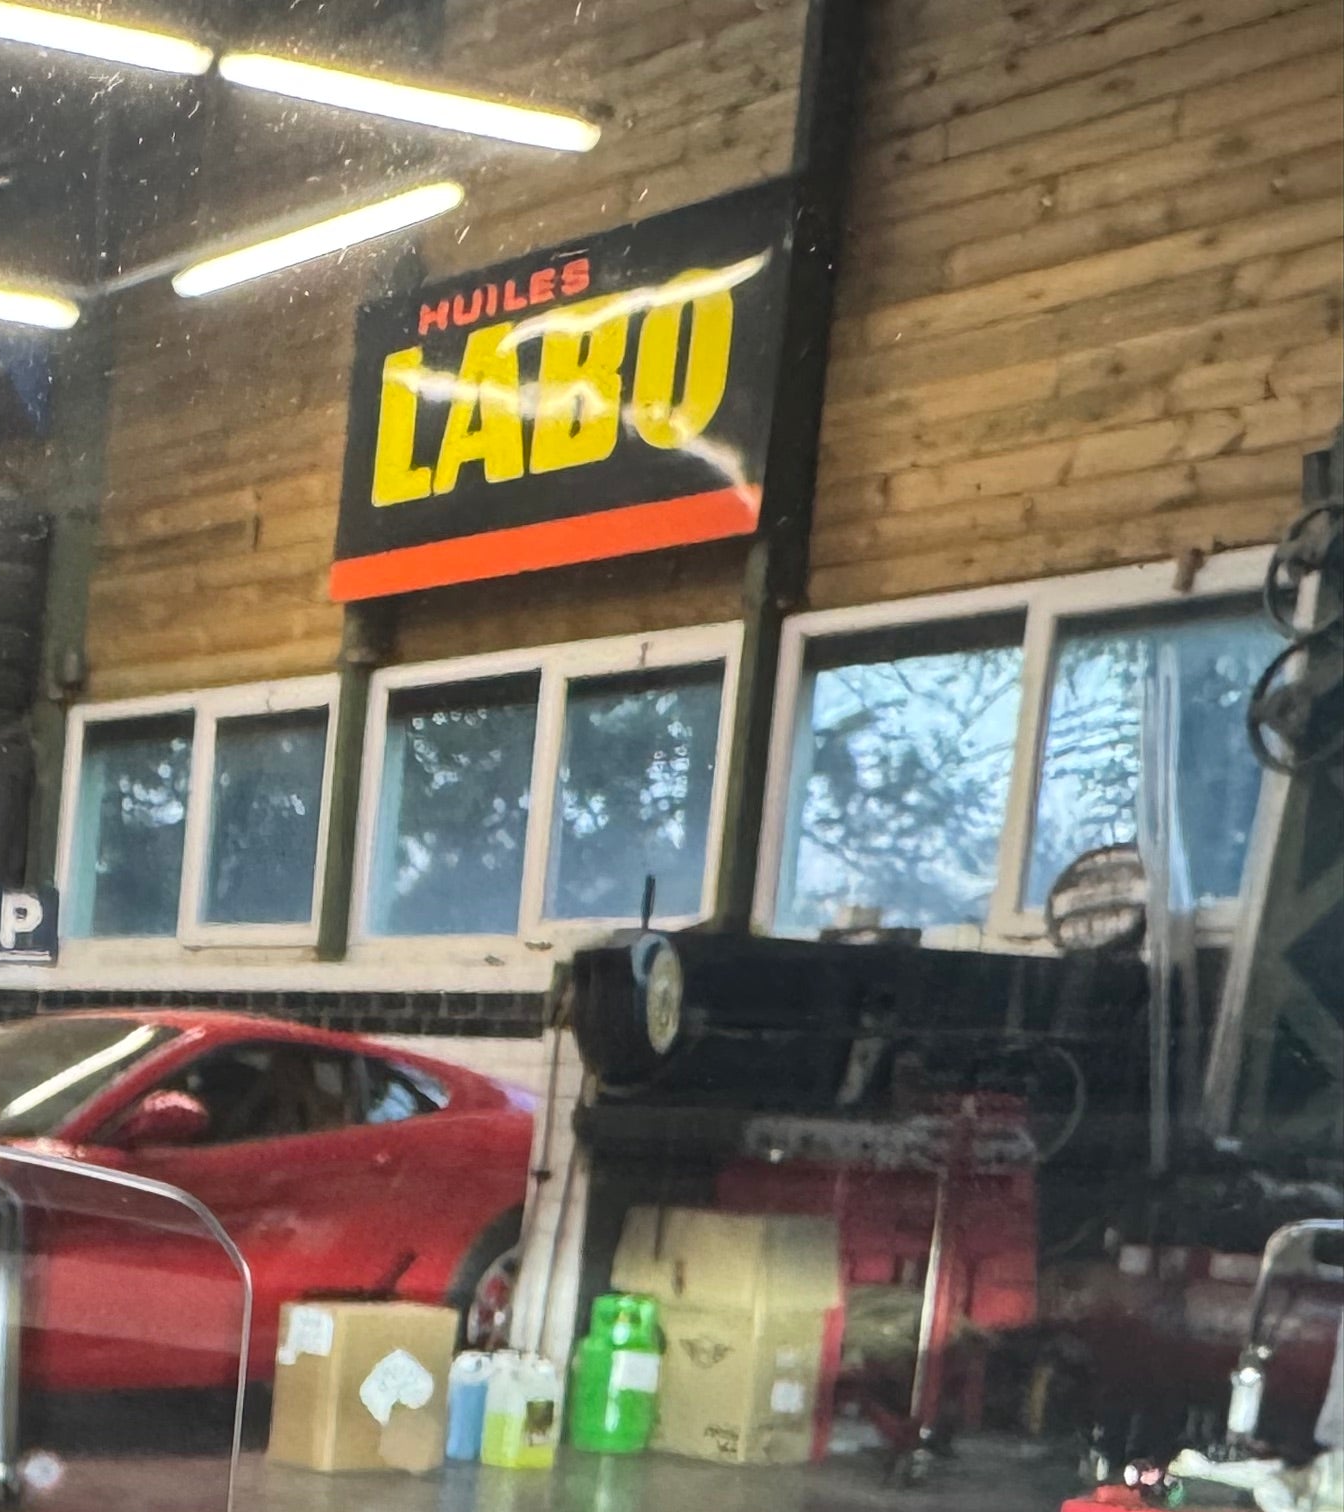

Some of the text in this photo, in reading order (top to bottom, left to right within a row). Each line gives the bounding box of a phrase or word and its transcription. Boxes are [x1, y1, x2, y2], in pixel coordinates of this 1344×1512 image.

[418, 259, 590, 335] HUILES
[372, 268, 734, 508] LABO
[0, 891, 44, 949] P
